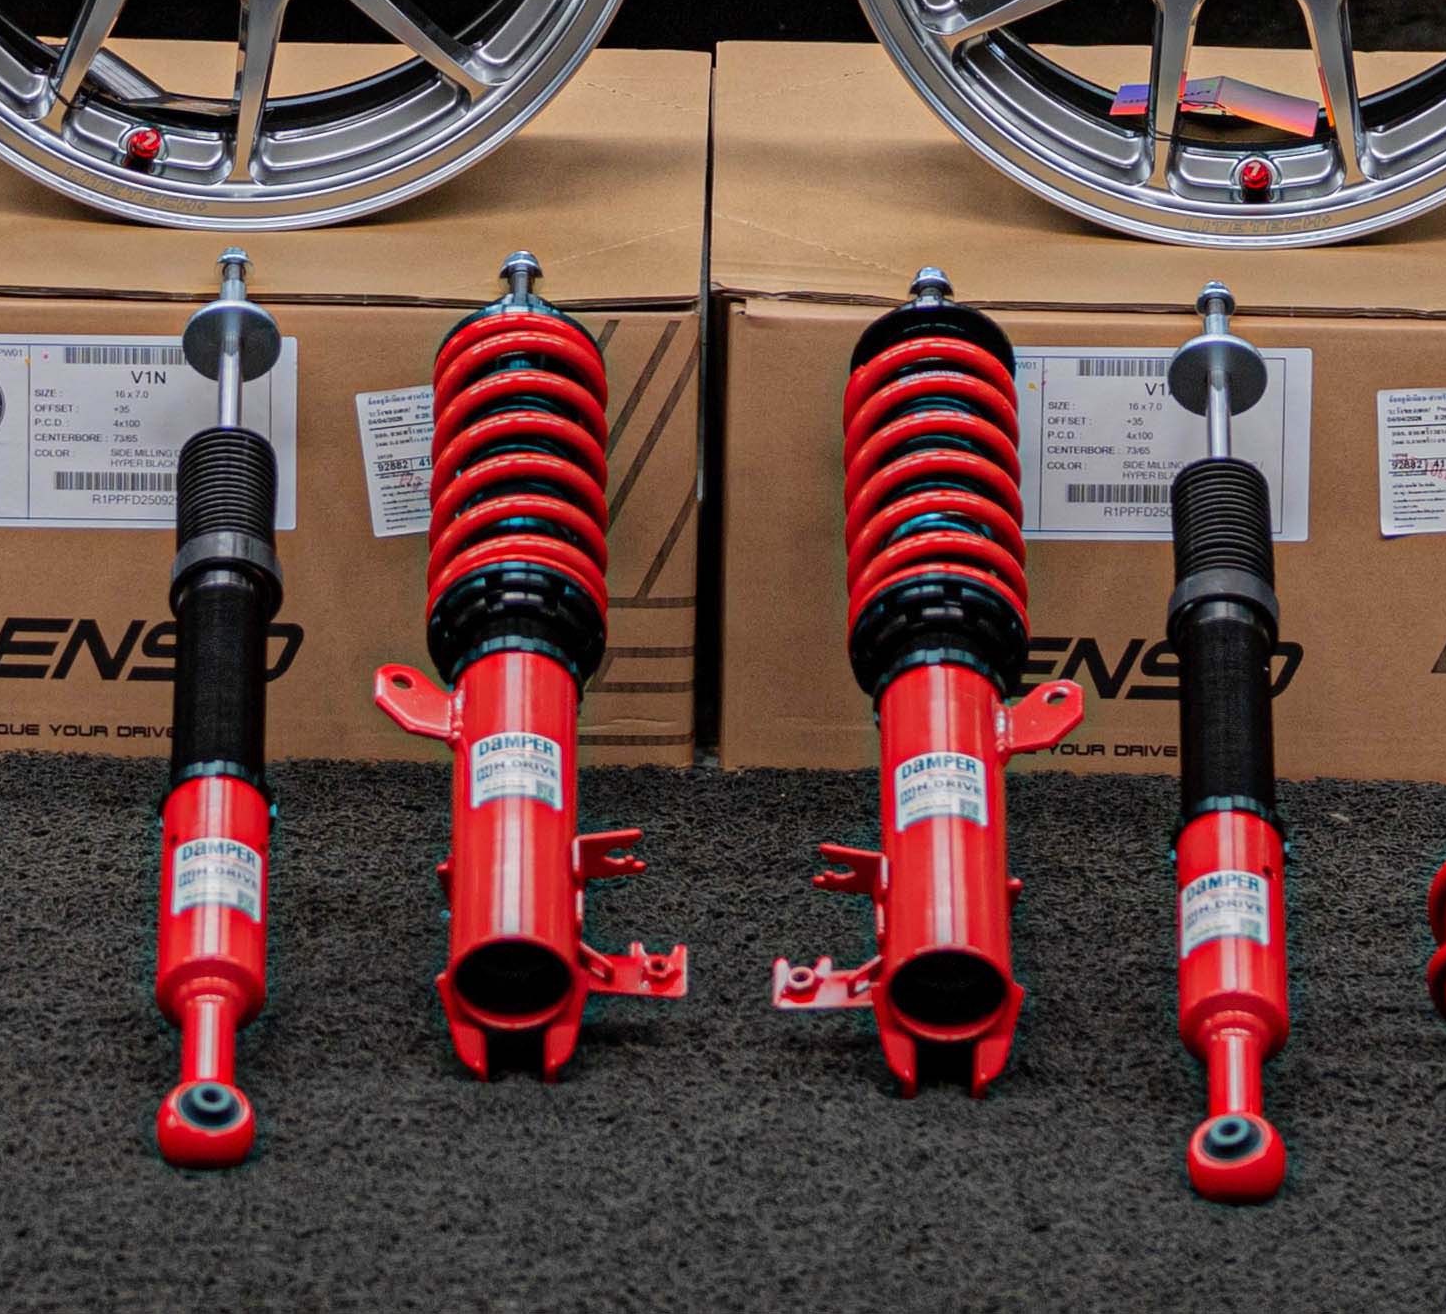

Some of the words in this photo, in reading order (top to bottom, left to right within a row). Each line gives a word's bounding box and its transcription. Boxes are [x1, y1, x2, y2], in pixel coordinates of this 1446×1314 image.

[131, 371, 167, 384] V1N
[34, 388, 57, 397] SIZE
[115, 389, 125, 398] 16
[136, 389, 149, 398] 7.0
[34, 404, 73, 413] OFFSET
[1048, 401, 1071, 410] SIZE
[1129, 402, 1138, 411] 16
[1149, 402, 1162, 411] 7.0
[113, 419, 140, 428] 4x100
[1048, 417, 1086, 426] OFFSET
[1126, 417, 1143, 426] +35
[34, 432, 102, 442] CENTERBORE
[1126, 431, 1153, 440] 4x100
[34, 448, 70, 458] COLOR
[110, 448, 133, 458] SIDE
[136, 448, 172, 459] MILLING
[1047, 445, 1115, 455] CENTERBORE
[1126, 446, 1150, 455] 73/65
[110, 459, 142, 468] HYPER
[1047, 461, 1083, 471] COLOR
[1122, 461, 1145, 470] SIDE
[1122, 471, 1154, 480] HYPER
[49, 725, 108, 737] YOUR
[1049, 744, 1105, 756] YOUR
[1114, 745, 1178, 757] DRIVE
